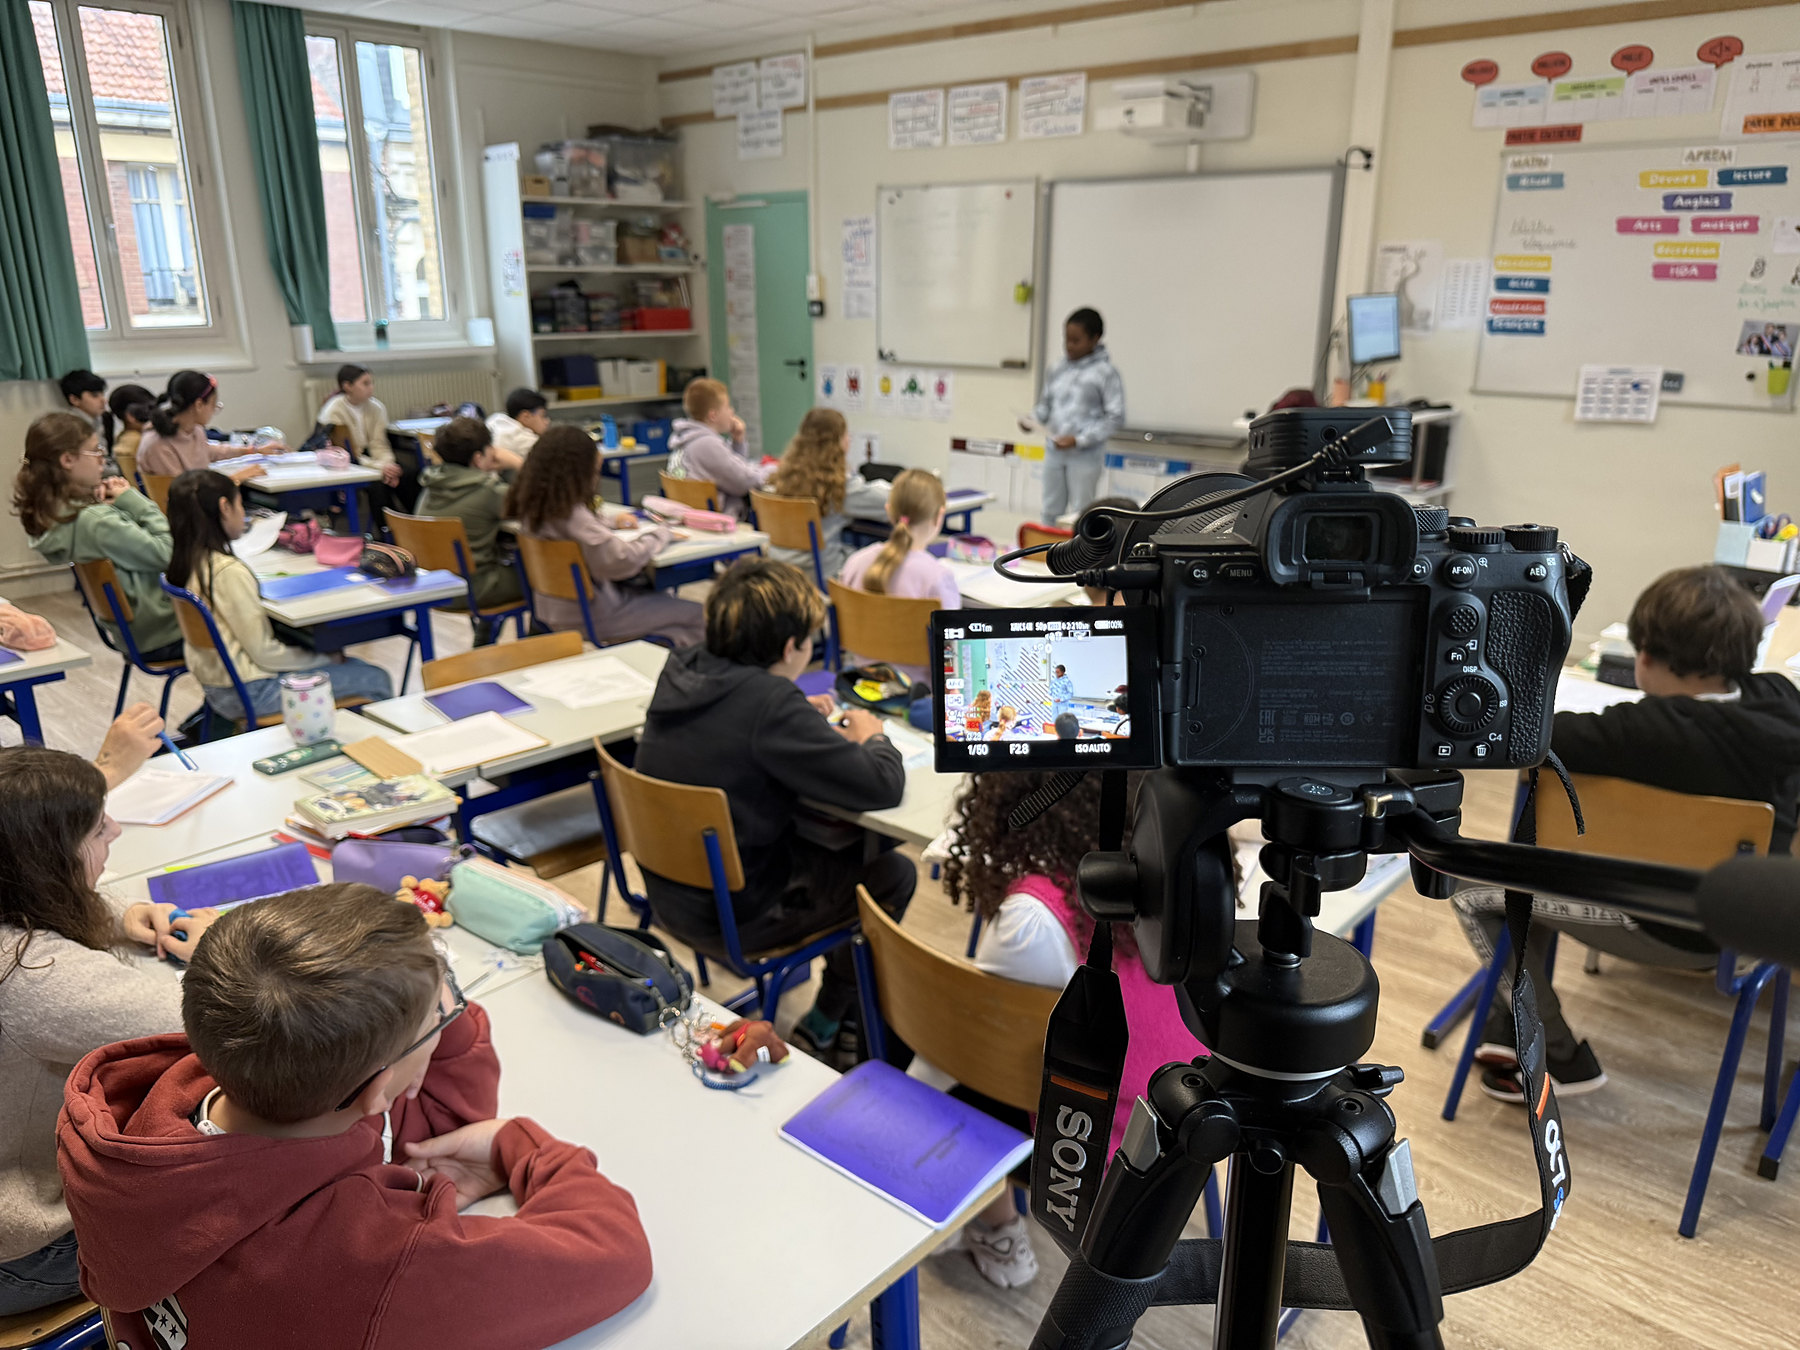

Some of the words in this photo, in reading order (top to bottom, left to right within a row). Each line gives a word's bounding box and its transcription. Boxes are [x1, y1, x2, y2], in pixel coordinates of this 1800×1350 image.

[1684, 150, 1733, 163] APREM
[1672, 195, 1720, 210] Anglais
[1193, 568, 1208, 579] C3
[1229, 569, 1253, 577] MENU
[1413, 564, 1427, 574] C1
[1451, 565, 1472, 575] AF-ON
[1529, 567, 1546, 577] AEL
[1451, 652, 1463, 661] Fn
[1462, 665, 1478, 673] DISP
[1488, 732, 1503, 741] C4
[1089, 742, 1112, 754] AUTO
[1046, 1104, 1093, 1233] SONY
